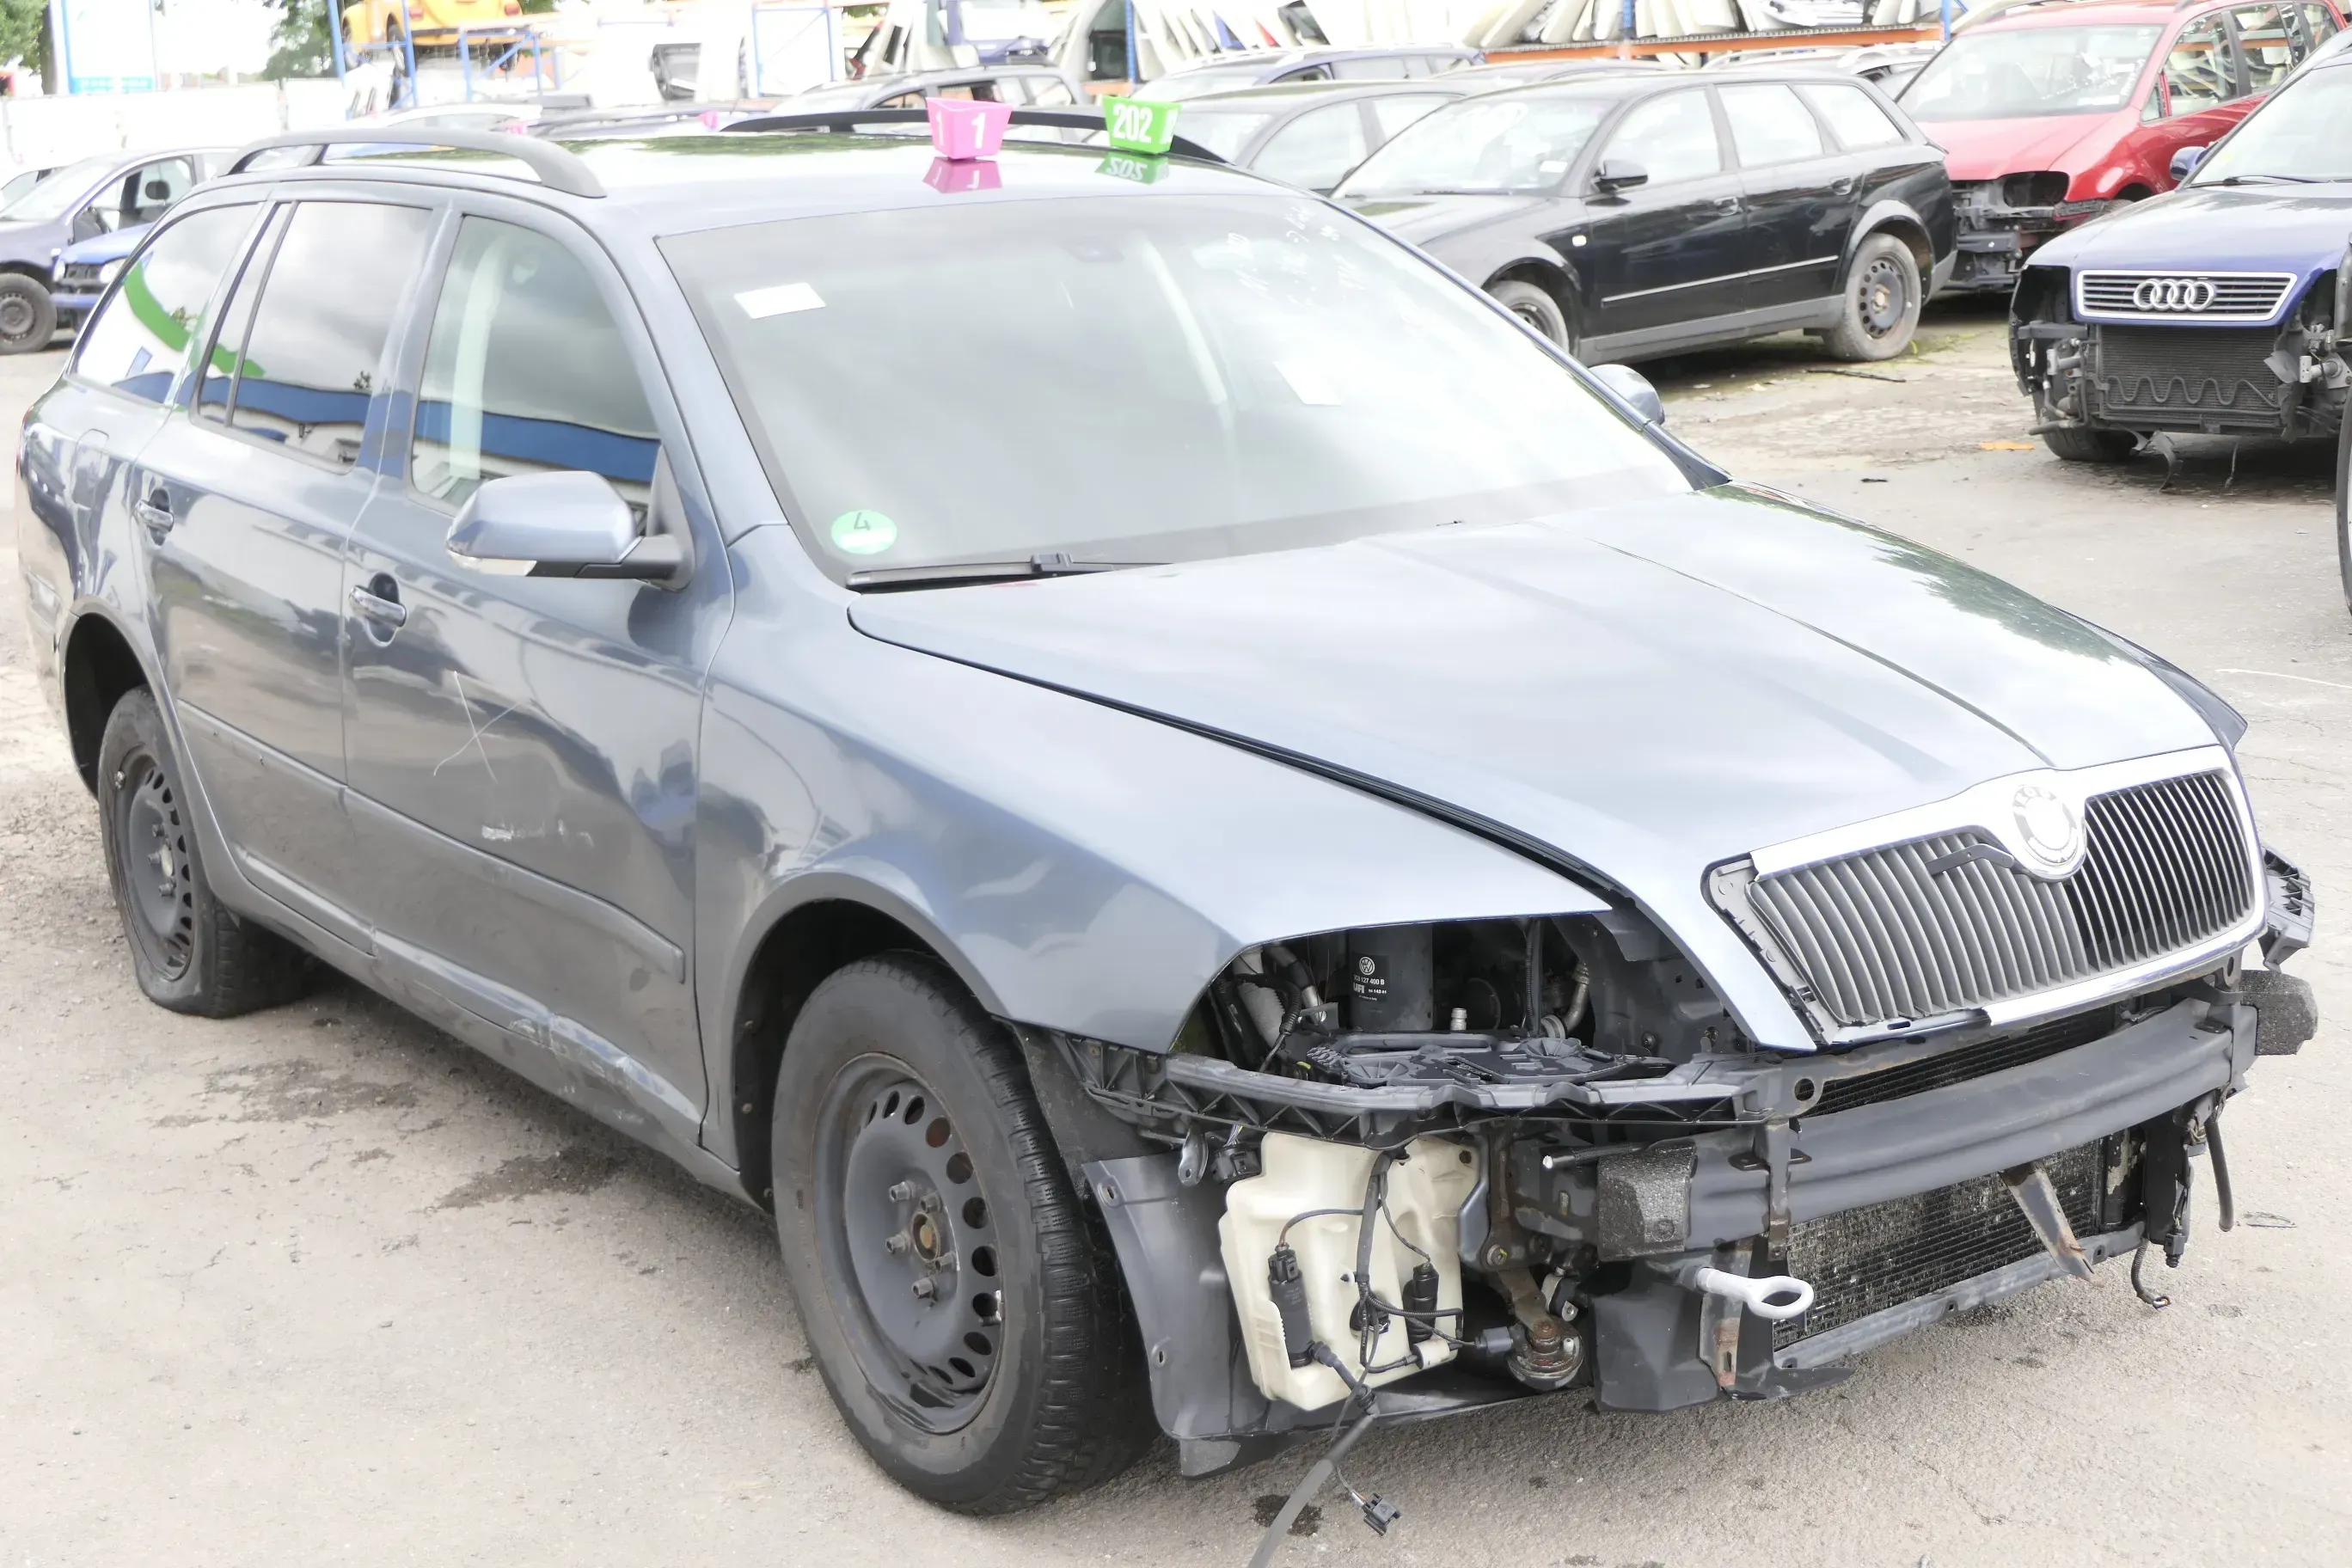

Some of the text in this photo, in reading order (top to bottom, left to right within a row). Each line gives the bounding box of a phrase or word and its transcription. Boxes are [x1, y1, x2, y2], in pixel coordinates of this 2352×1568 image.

[935, 110, 944, 147] 1
[971, 112, 986, 150] 1
[1112, 102, 1153, 144] 202
[854, 511, 871, 531] 4
